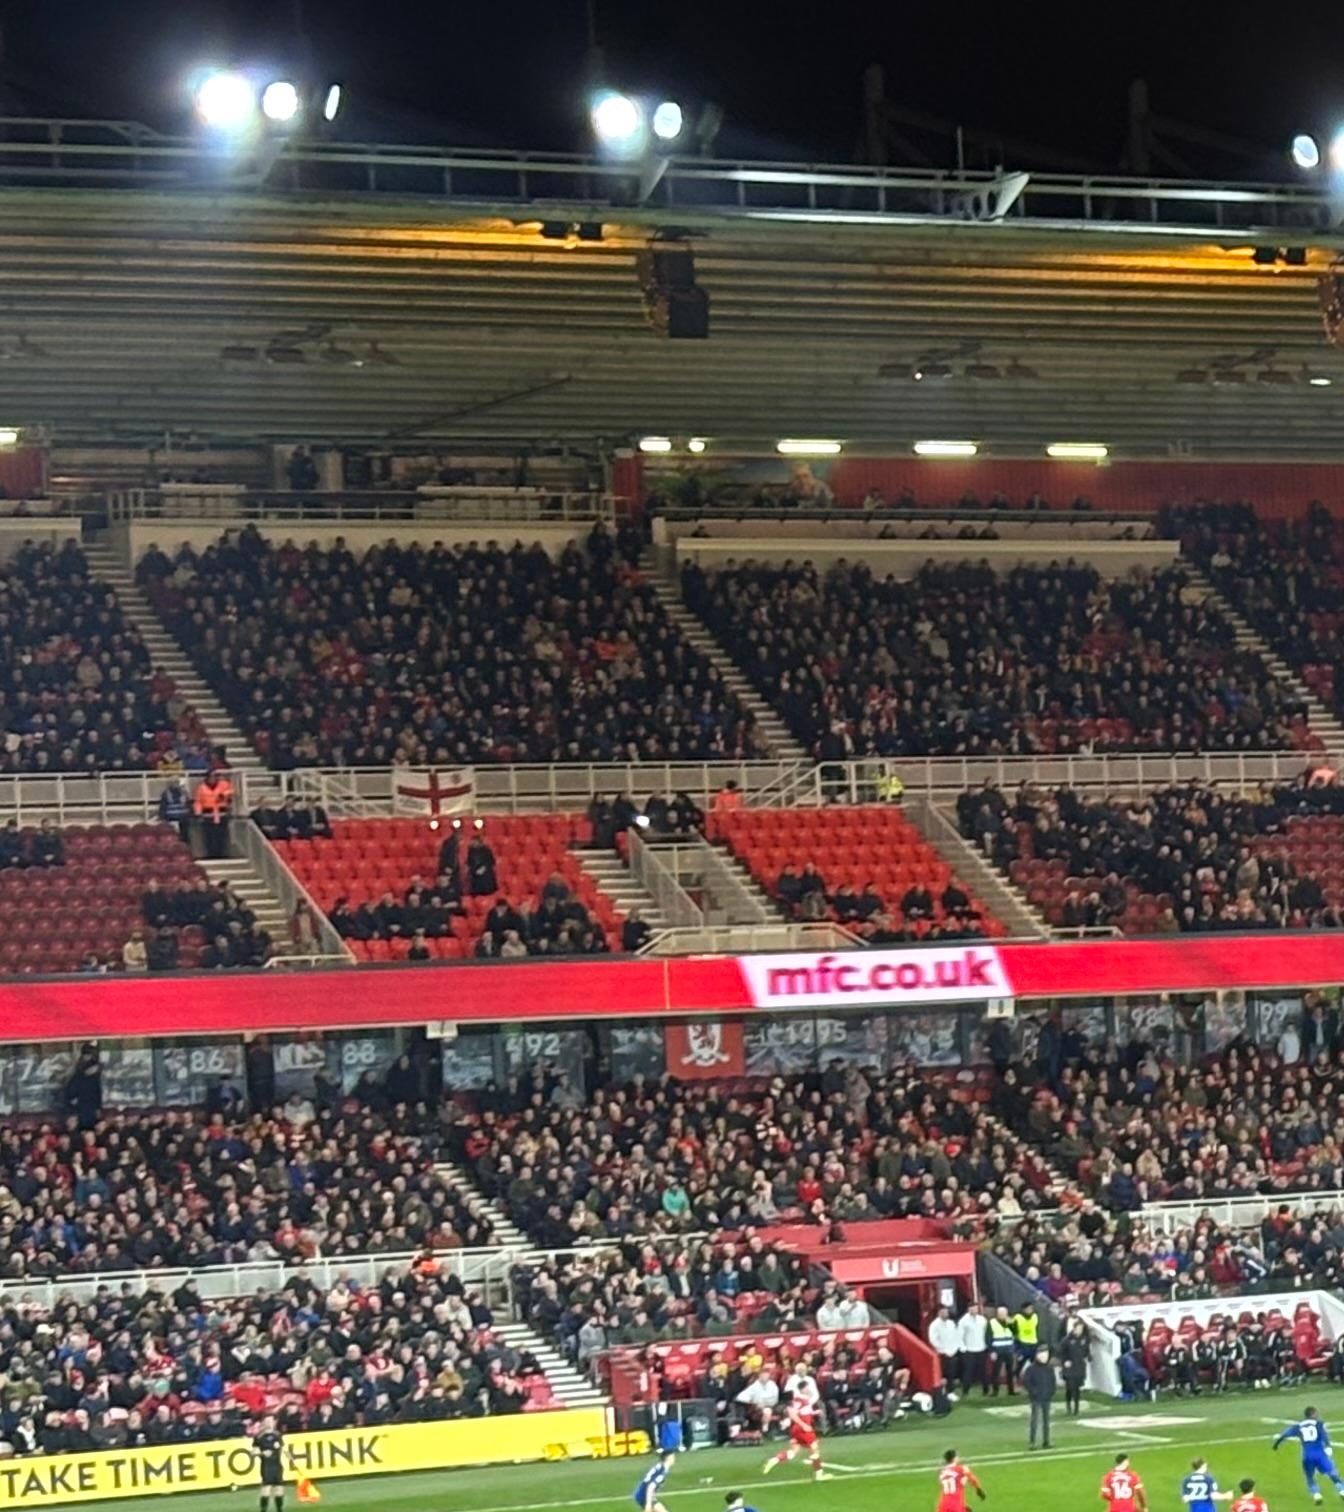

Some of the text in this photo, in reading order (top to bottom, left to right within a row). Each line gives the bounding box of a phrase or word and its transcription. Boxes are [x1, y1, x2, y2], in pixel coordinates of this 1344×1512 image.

[767, 951, 997, 995] mfc.co.uk
[1299, 1425, 1318, 1442] 10
[2, 1435, 383, 1499] TAKE TIME TO HINK
[1112, 1481, 1133, 1500] 16
[1187, 1482, 1209, 1501] 22
